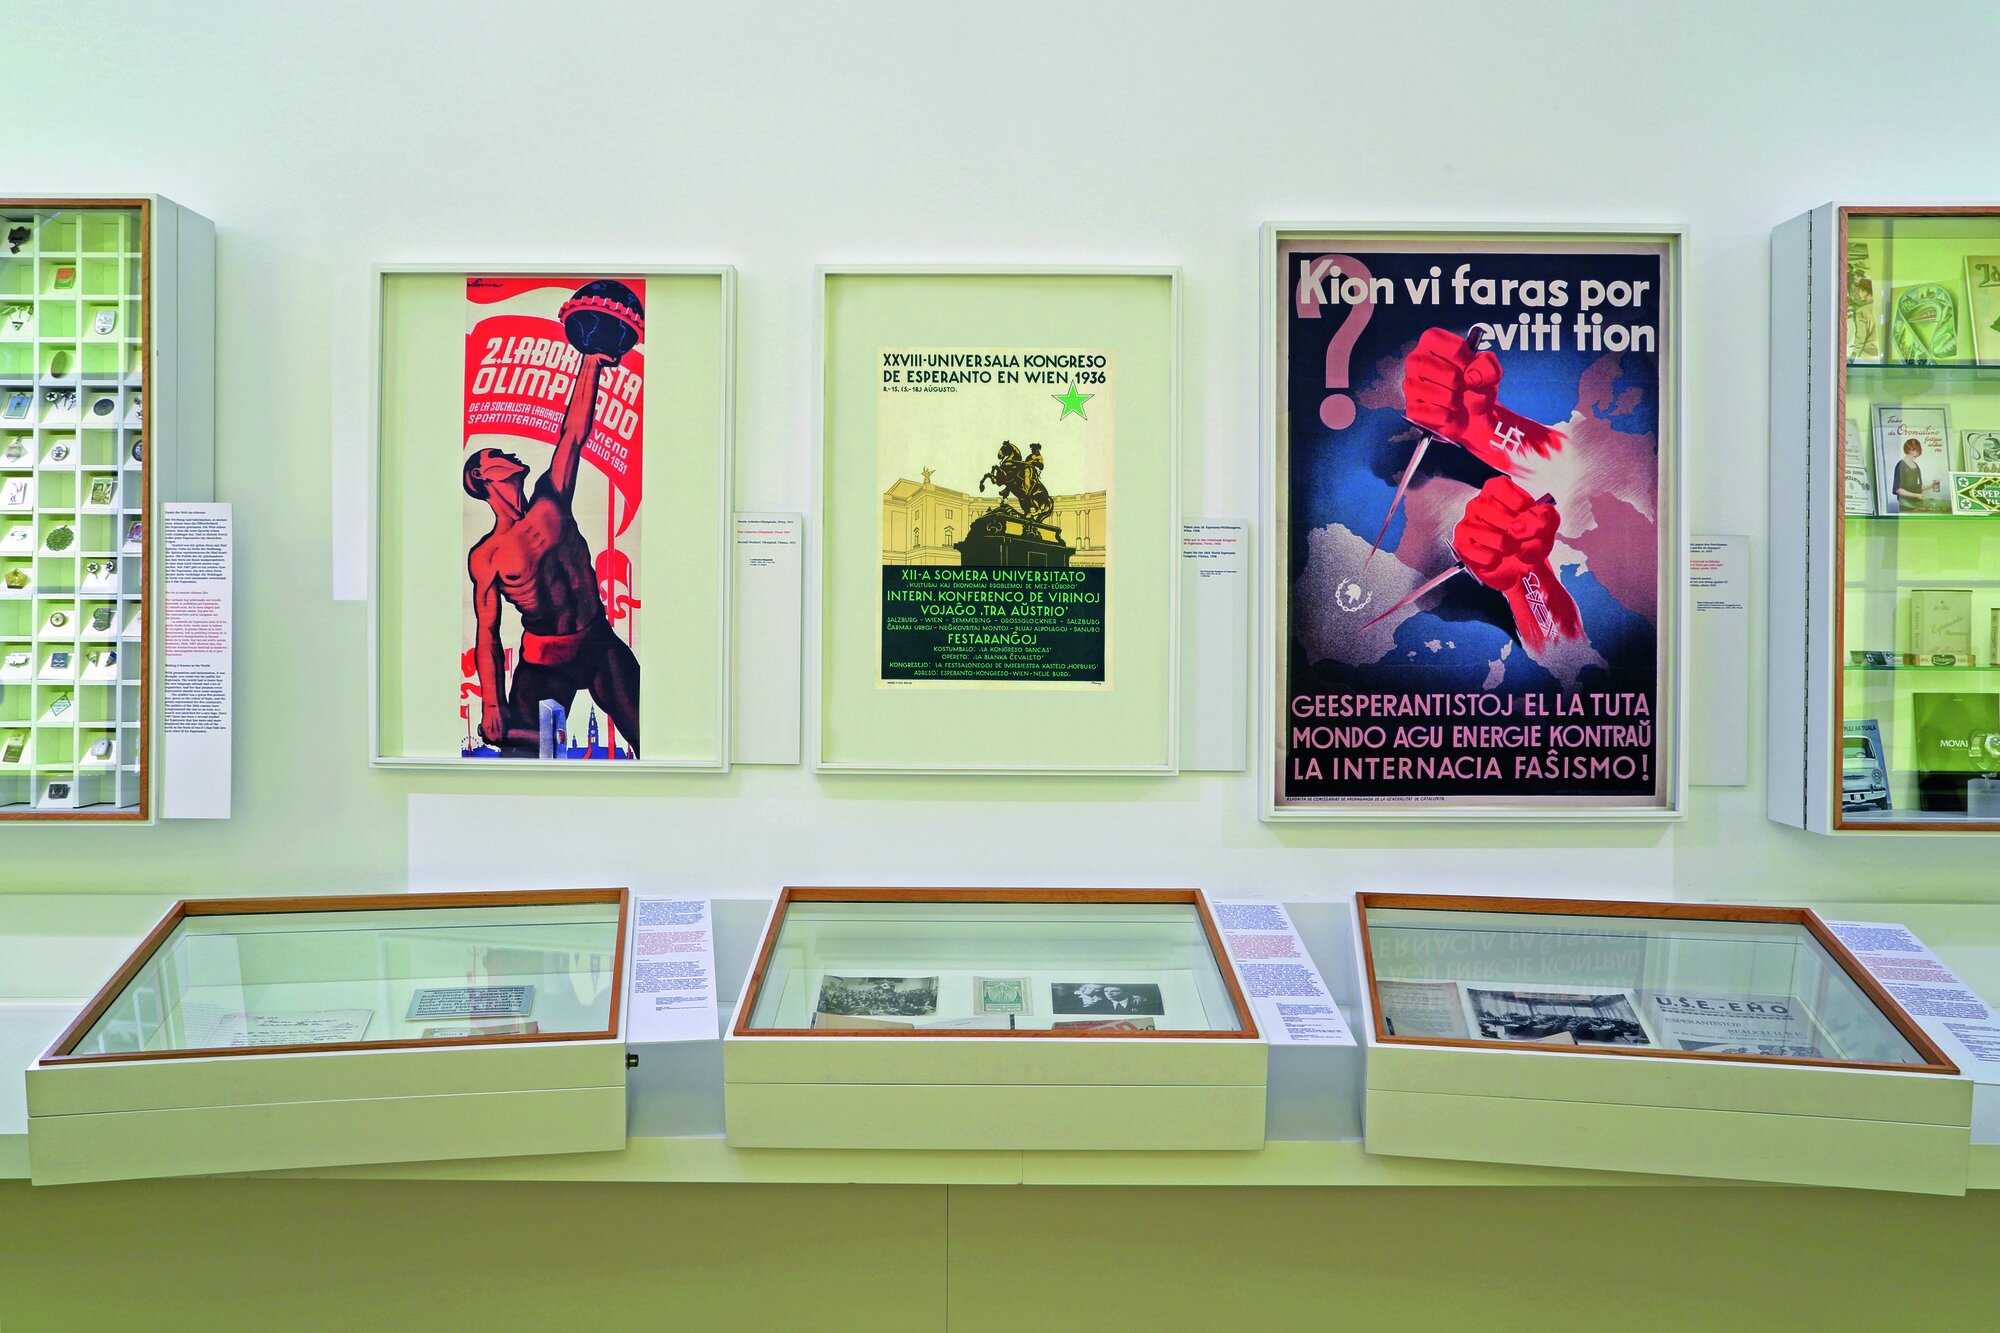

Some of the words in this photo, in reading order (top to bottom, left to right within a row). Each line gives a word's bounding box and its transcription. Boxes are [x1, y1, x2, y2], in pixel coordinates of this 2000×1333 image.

[1300, 259, 1394, 305] Kion
[1404, 265, 1441, 305] vi
[1452, 263, 1568, 307] faras
[1581, 279, 1650, 311] por
[1468, 312, 1561, 352] eviti
[1573, 312, 1655, 353] tion
[1023, 354, 1107, 368] KONGRESO
[883, 370, 900, 383] DE
[907, 371, 992, 384] ESPERANTO
[997, 371, 1019, 384] EN
[1024, 372, 1068, 384] WIEN
[1075, 372, 1107, 385] 1936
[469, 401, 479, 412] DE
[480, 401, 490, 412] LA
[490, 401, 531, 414] SOCIALISTA
[468, 413, 559, 434] SPORTINTERNACIO
[593, 429, 628, 460] VIENO
[586, 438, 611, 462] JULIO
[610, 455, 628, 475] 1931
[901, 570, 931, 581] XII-A
[934, 570, 989, 581] SOMERA
[992, 570, 1086, 582] UNIVERSITATO
[887, 590, 936, 602] INTERN.
[938, 591, 1024, 602] KONFERENCO
[1029, 592, 1044, 603] DE
[1048, 592, 1100, 603] VIRINOJ
[920, 602, 976, 616] VOJAĜO
[947, 631, 1038, 646] FESTARANĜOJ
[1291, 693, 1513, 718] GEESPERANTISTOJ
[1525, 693, 1550, 716] EL
[1556, 693, 1584, 716] LA
[1590, 693, 1650, 716] TUTA
[1293, 726, 1387, 749] MONDO
[1393, 726, 1443, 748] AGU
[1452, 725, 1541, 748] ENERGIE
[1550, 719, 1651, 748] KONTRAŬ
[1294, 757, 1323, 780] LA
[1333, 757, 1503, 780] INTERNACIA
